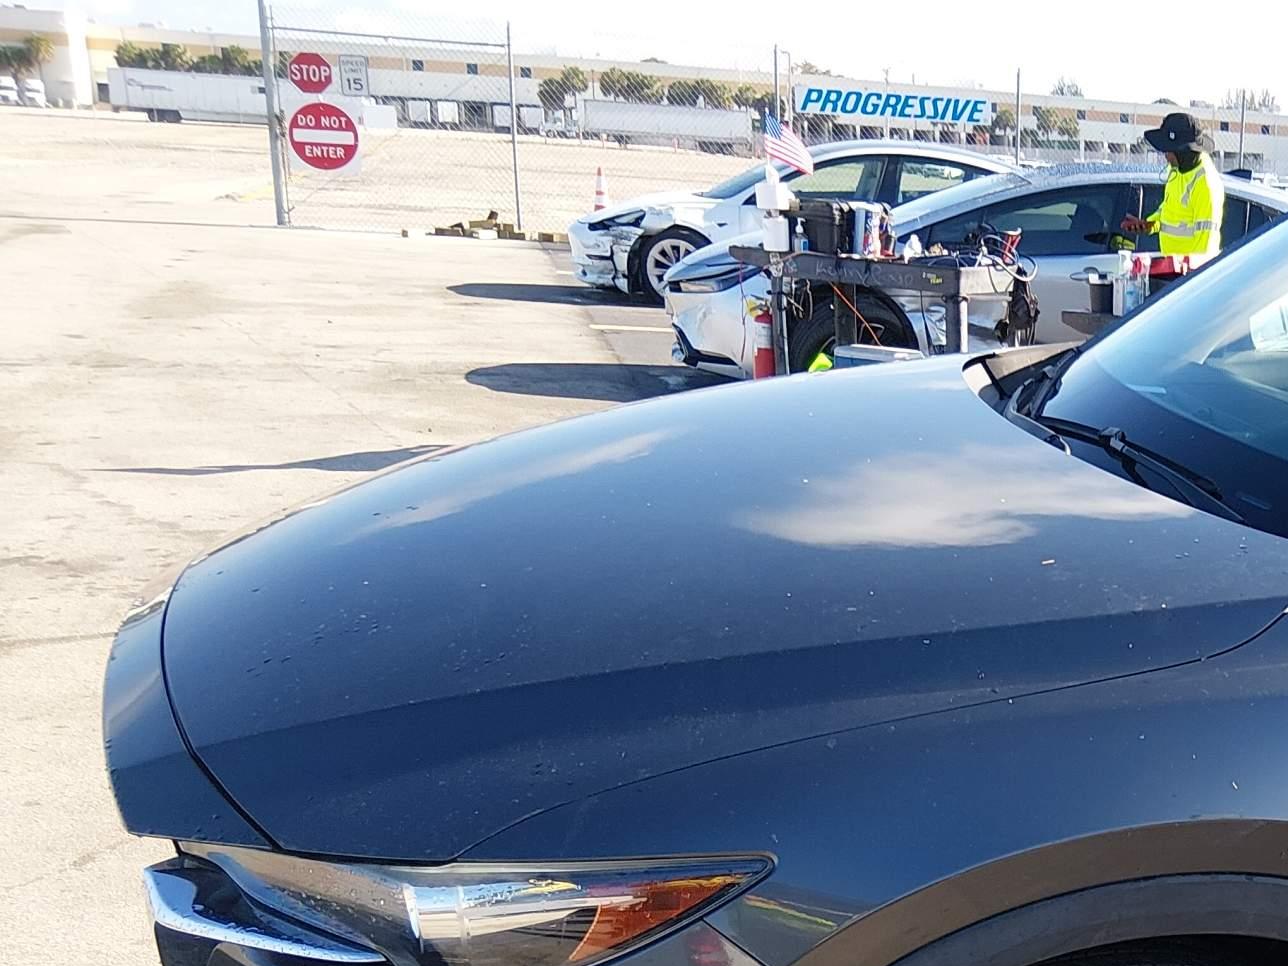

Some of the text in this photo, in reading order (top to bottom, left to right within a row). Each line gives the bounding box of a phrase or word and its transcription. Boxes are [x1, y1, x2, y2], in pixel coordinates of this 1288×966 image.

[290, 64, 330, 82] STOP
[346, 78, 364, 91] 15
[800, 88, 987, 123] PROGRESSIVE
[297, 115, 348, 128] DO NOT
[304, 145, 345, 159] ENTER
